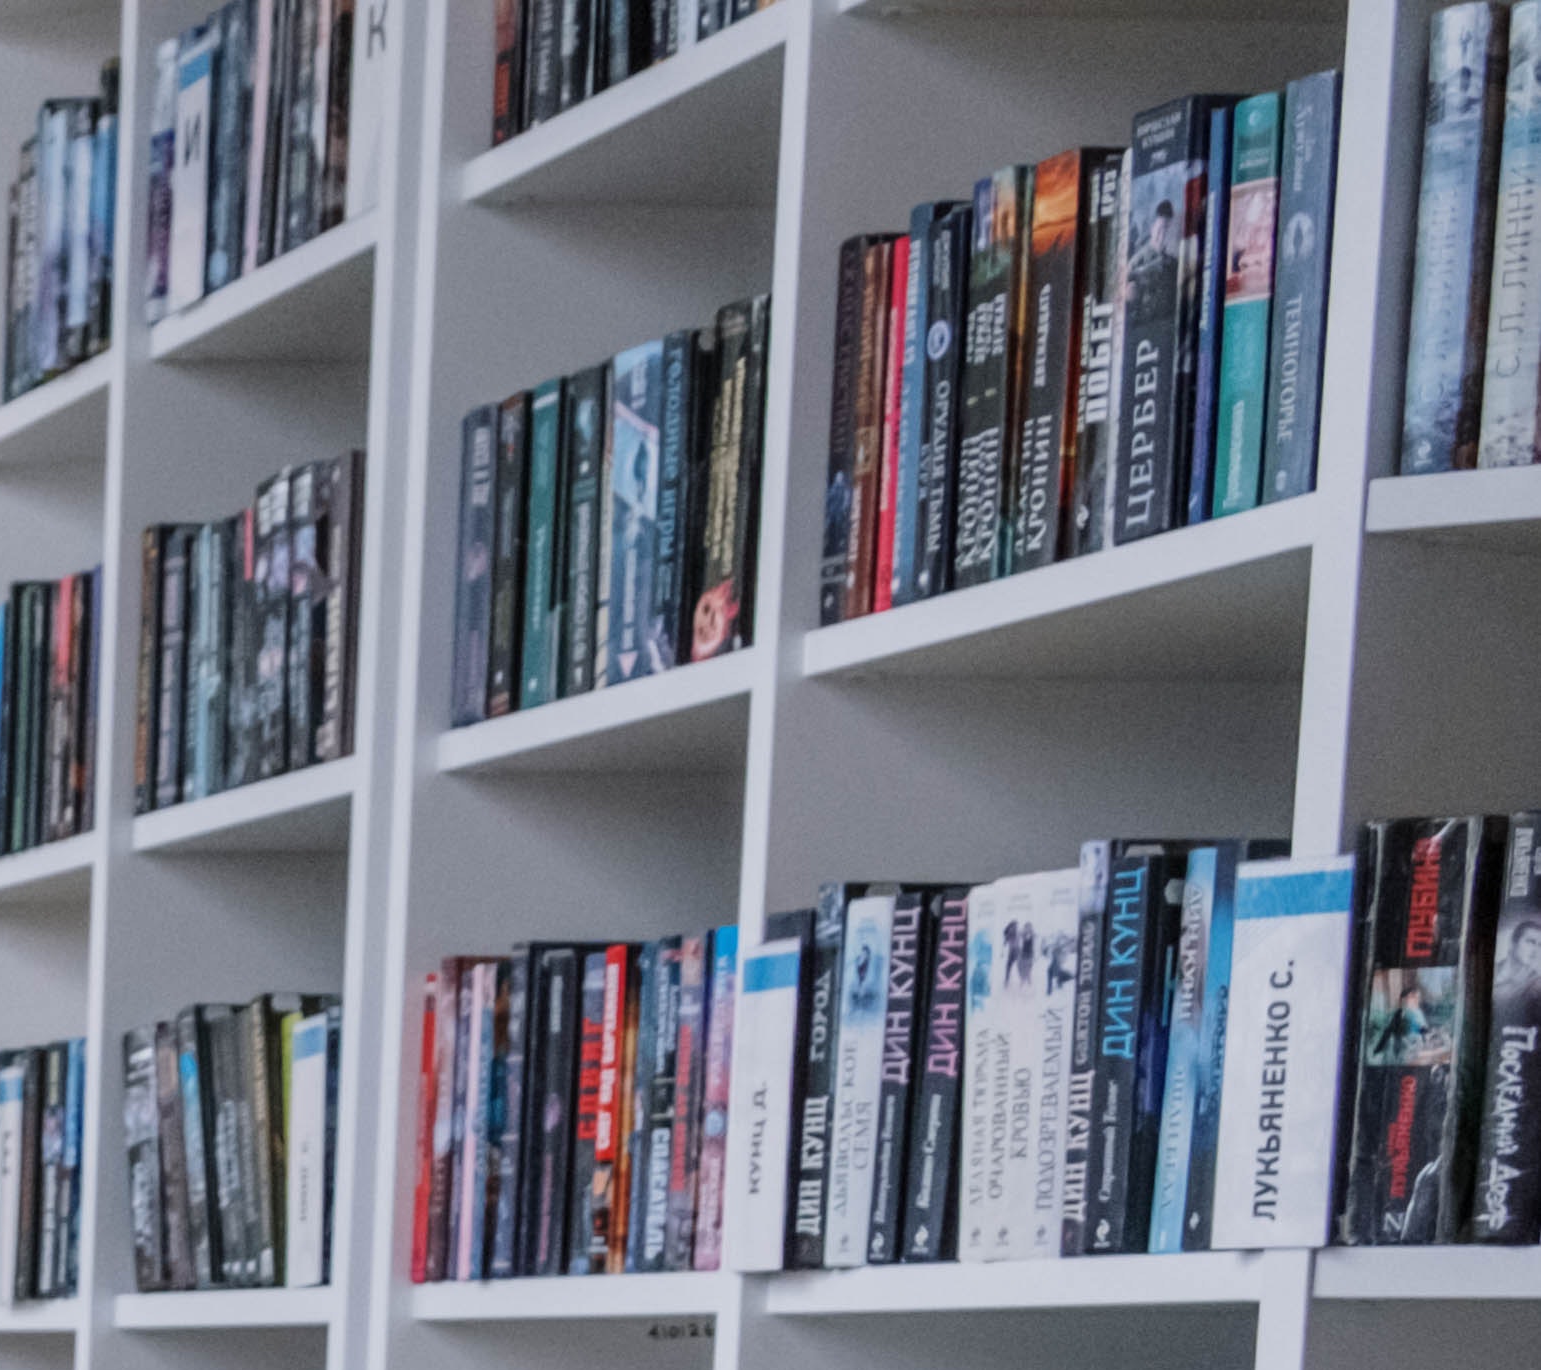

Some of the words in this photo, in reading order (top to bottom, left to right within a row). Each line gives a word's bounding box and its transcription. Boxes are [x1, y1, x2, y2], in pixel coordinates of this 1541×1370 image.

[1085, 298, 1115, 424] ПОБЕГ
[1275, 291, 1304, 445] ТЕМНОГОРЬЕ
[931, 379, 952, 478] ОРУДИЯ
[1125, 338, 1161, 528] ЦЕРБЕР
[925, 484, 947, 553] ТЬМЫ
[978, 426, 1000, 561] КРОНИН
[1025, 413, 1052, 552] КРОНИН
[885, 905, 922, 999] КУНЦ
[934, 898, 968, 991] КУНЦ
[1108, 866, 1147, 967] КУНЦ
[1101, 980, 1136, 1059] ДИН
[1272, 958, 1296, 992] С.
[881, 1011, 911, 1085] ДИН
[927, 1002, 959, 1078] ДИН
[747, 1115, 769, 1195] КУНЦ
[800, 1094, 829, 1170] КУНЦ
[987, 1033, 1012, 1199] ОЧАРОВАННЫЙ
[1010, 1067, 1033, 1160] КРОВЬЮ
[1035, 1007, 1065, 1211] ПОДОЗРЕВАЕМЫЙ
[1065, 1069, 1096, 1153] КУНЦ
[1254, 994, 1292, 1223] ЛУКЬЯНЕНКО
[644, 1127, 672, 1260] СПАСАТЕЛЬ
[796, 1178, 823, 1236] ДИН
[1062, 1157, 1090, 1223] ДИН
